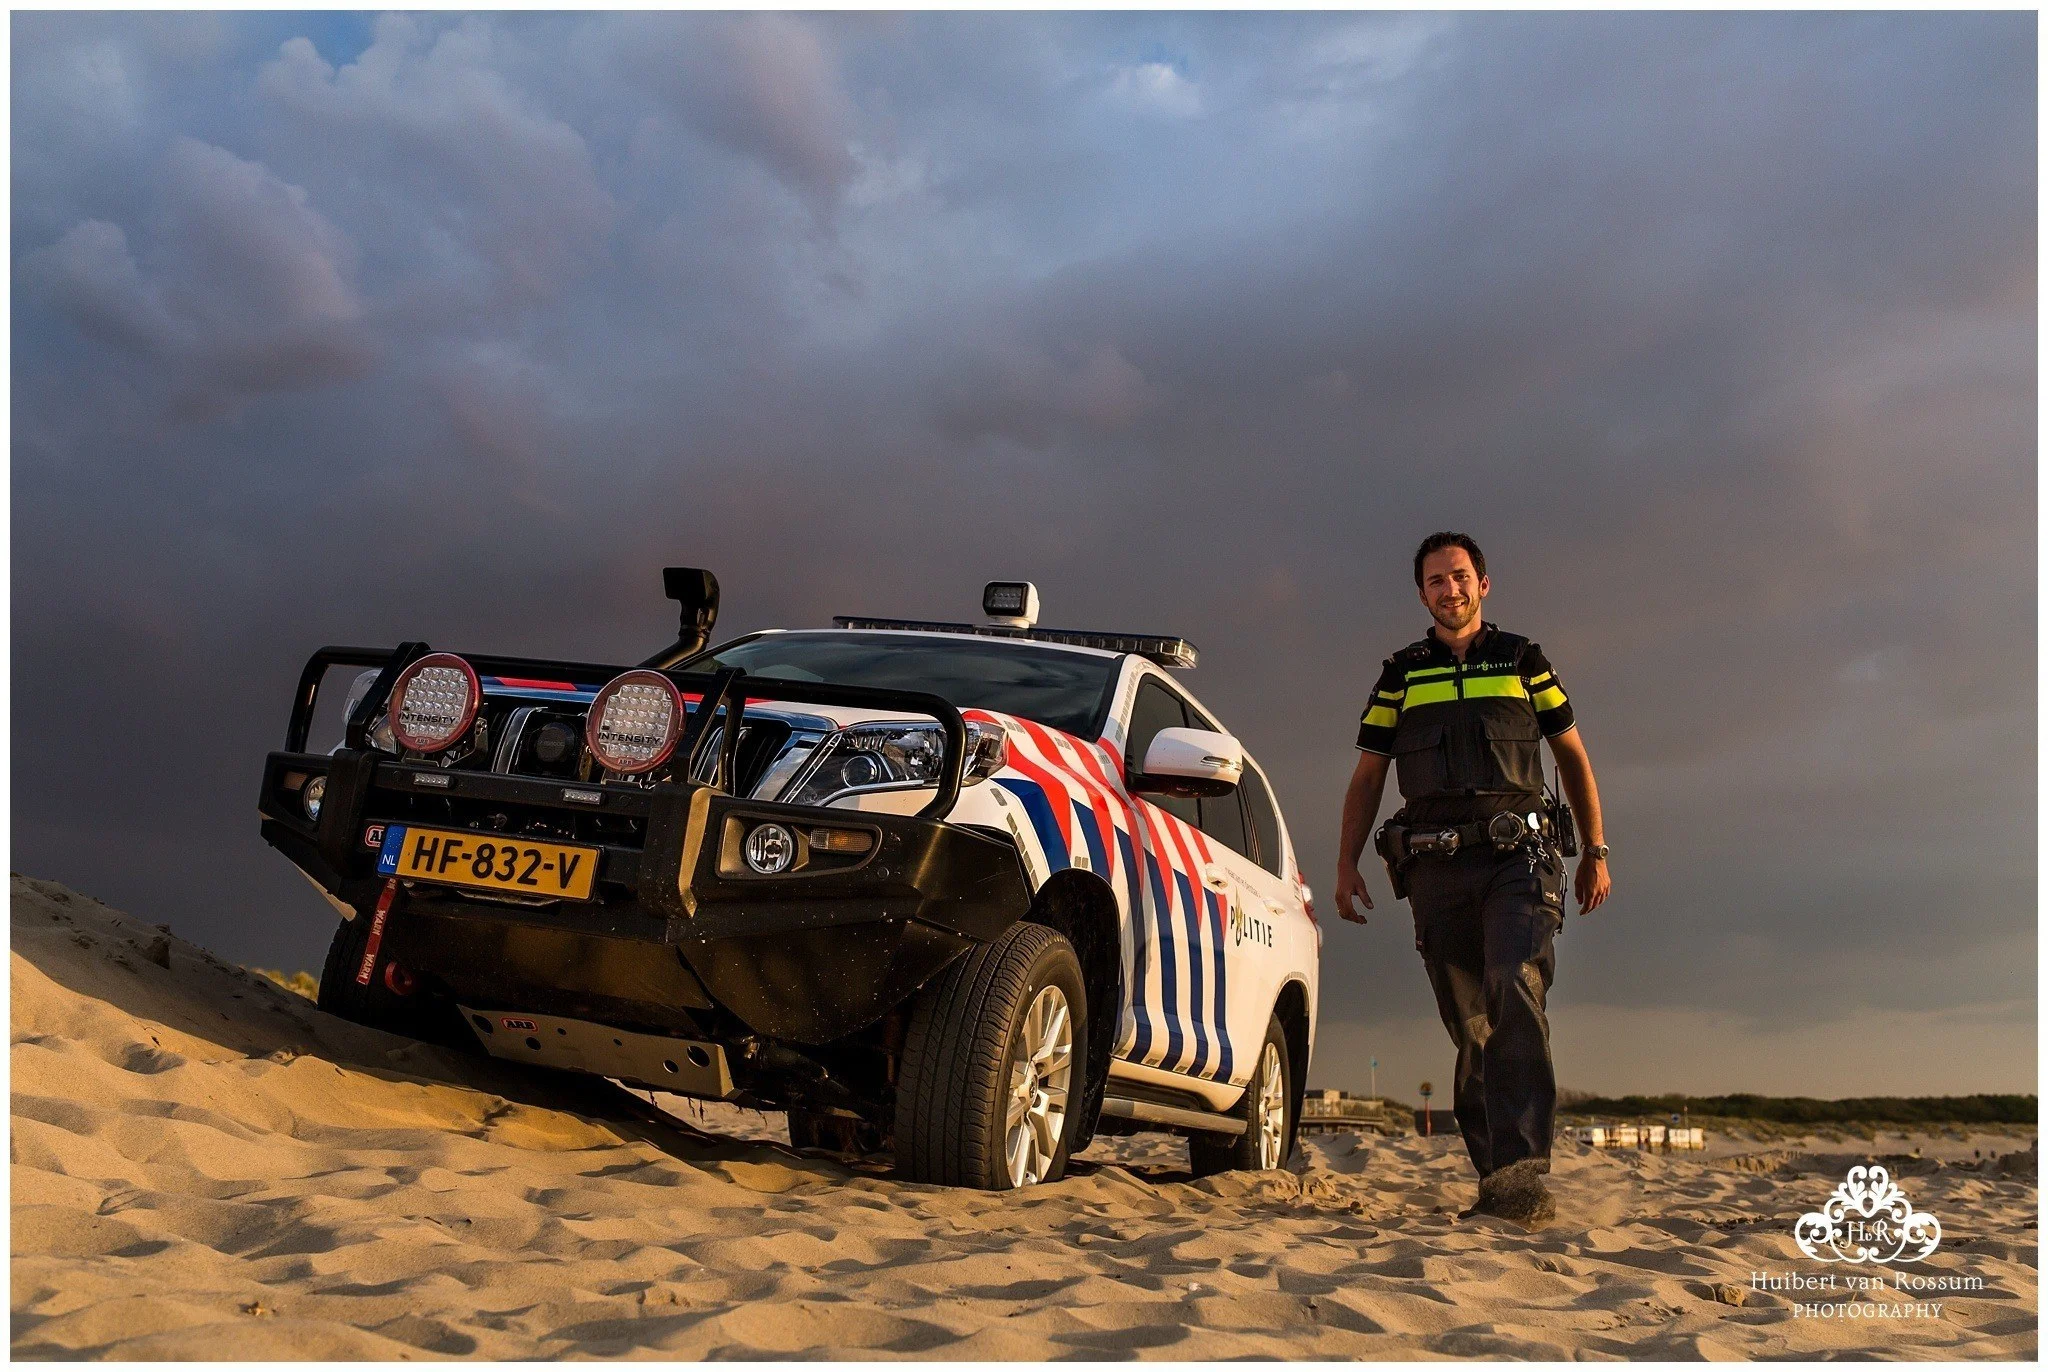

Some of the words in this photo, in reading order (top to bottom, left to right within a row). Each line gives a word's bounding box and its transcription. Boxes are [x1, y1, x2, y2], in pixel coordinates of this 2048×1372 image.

[1476, 661, 1513, 671] POLITIE
[599, 732, 661, 745] INTENSITY
[382, 854, 396, 866] NL
[411, 835, 581, 889] HF-832-V
[371, 909, 387, 936] WARN
[1230, 901, 1273, 948] POLITIE
[359, 953, 375, 979] WARN
[505, 1020, 536, 1030] ARB
